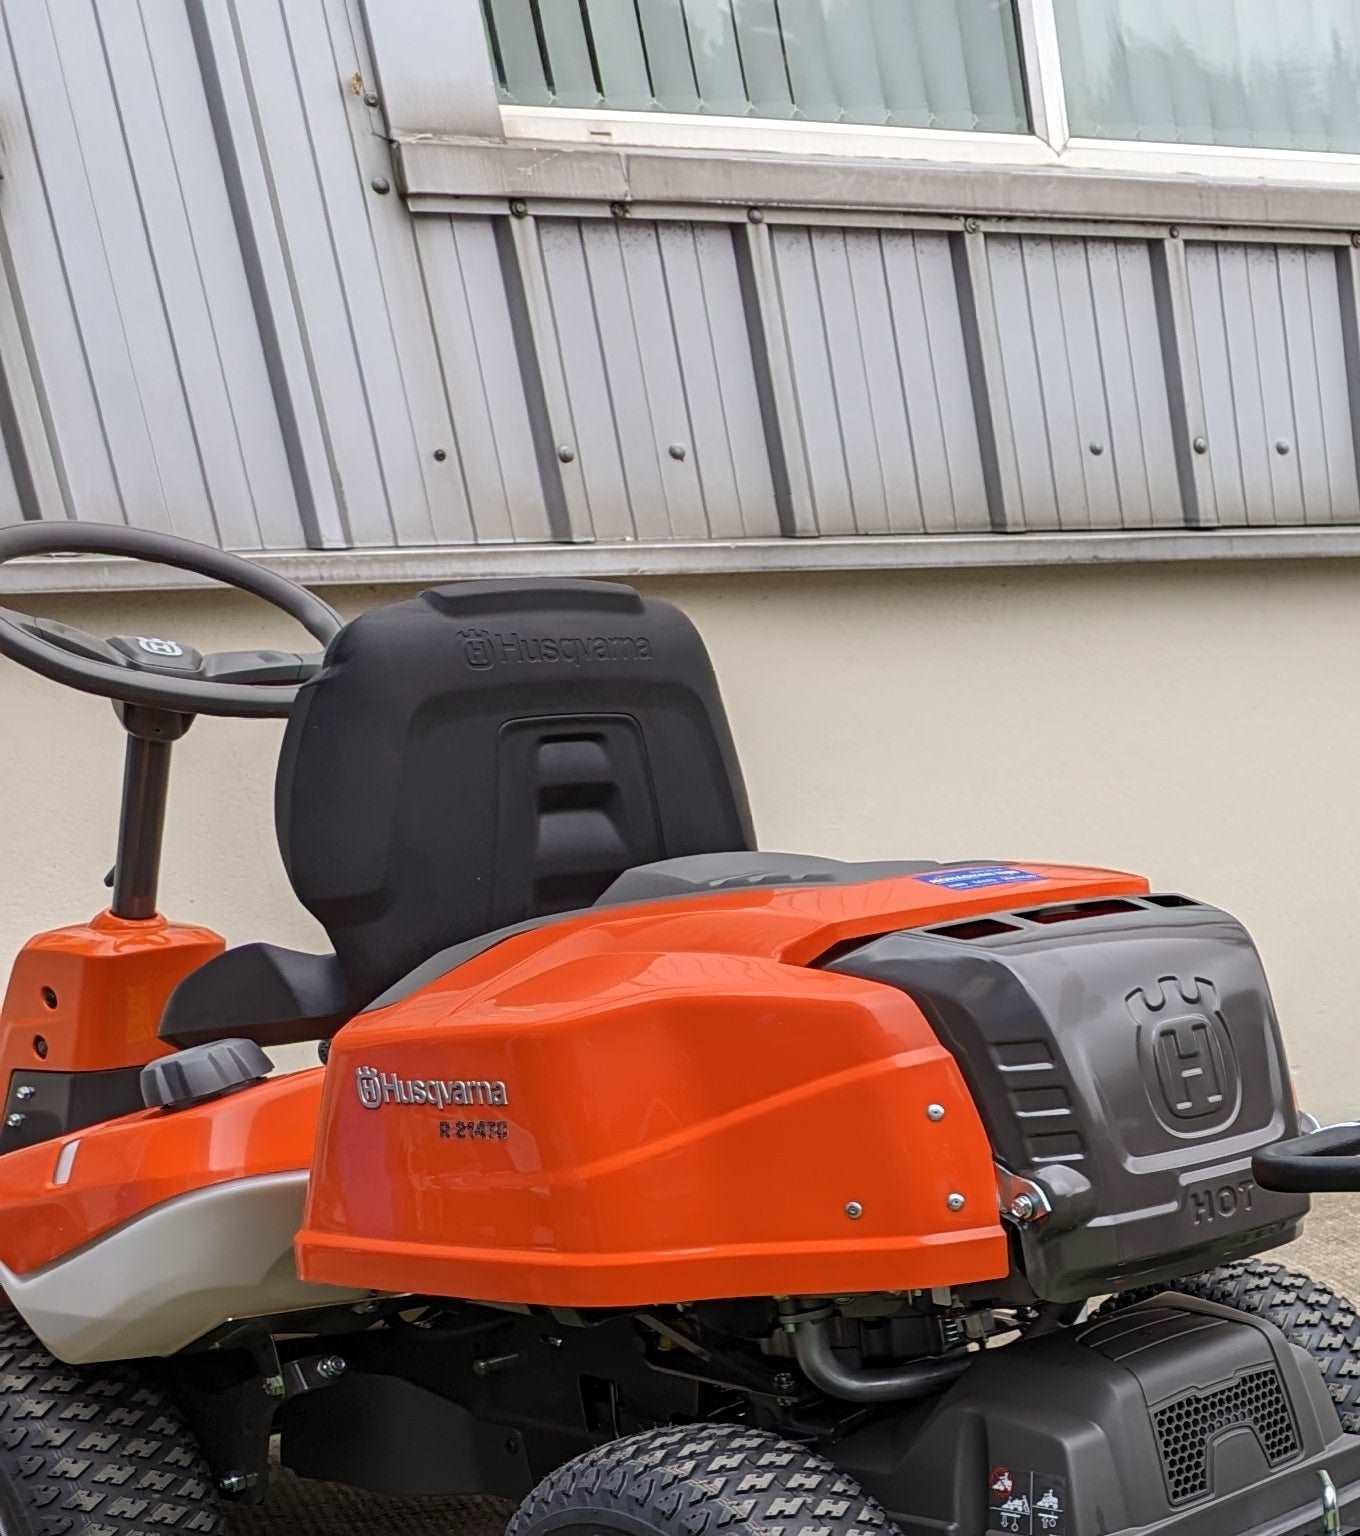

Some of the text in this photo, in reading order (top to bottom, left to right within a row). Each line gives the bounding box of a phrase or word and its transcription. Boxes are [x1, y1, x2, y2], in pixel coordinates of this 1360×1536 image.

[494, 631, 653, 667] Husqvarna
[379, 1072, 508, 1110] Husqvarna
[439, 1120, 450, 1138] R
[1189, 1178, 1254, 1226] HOT
